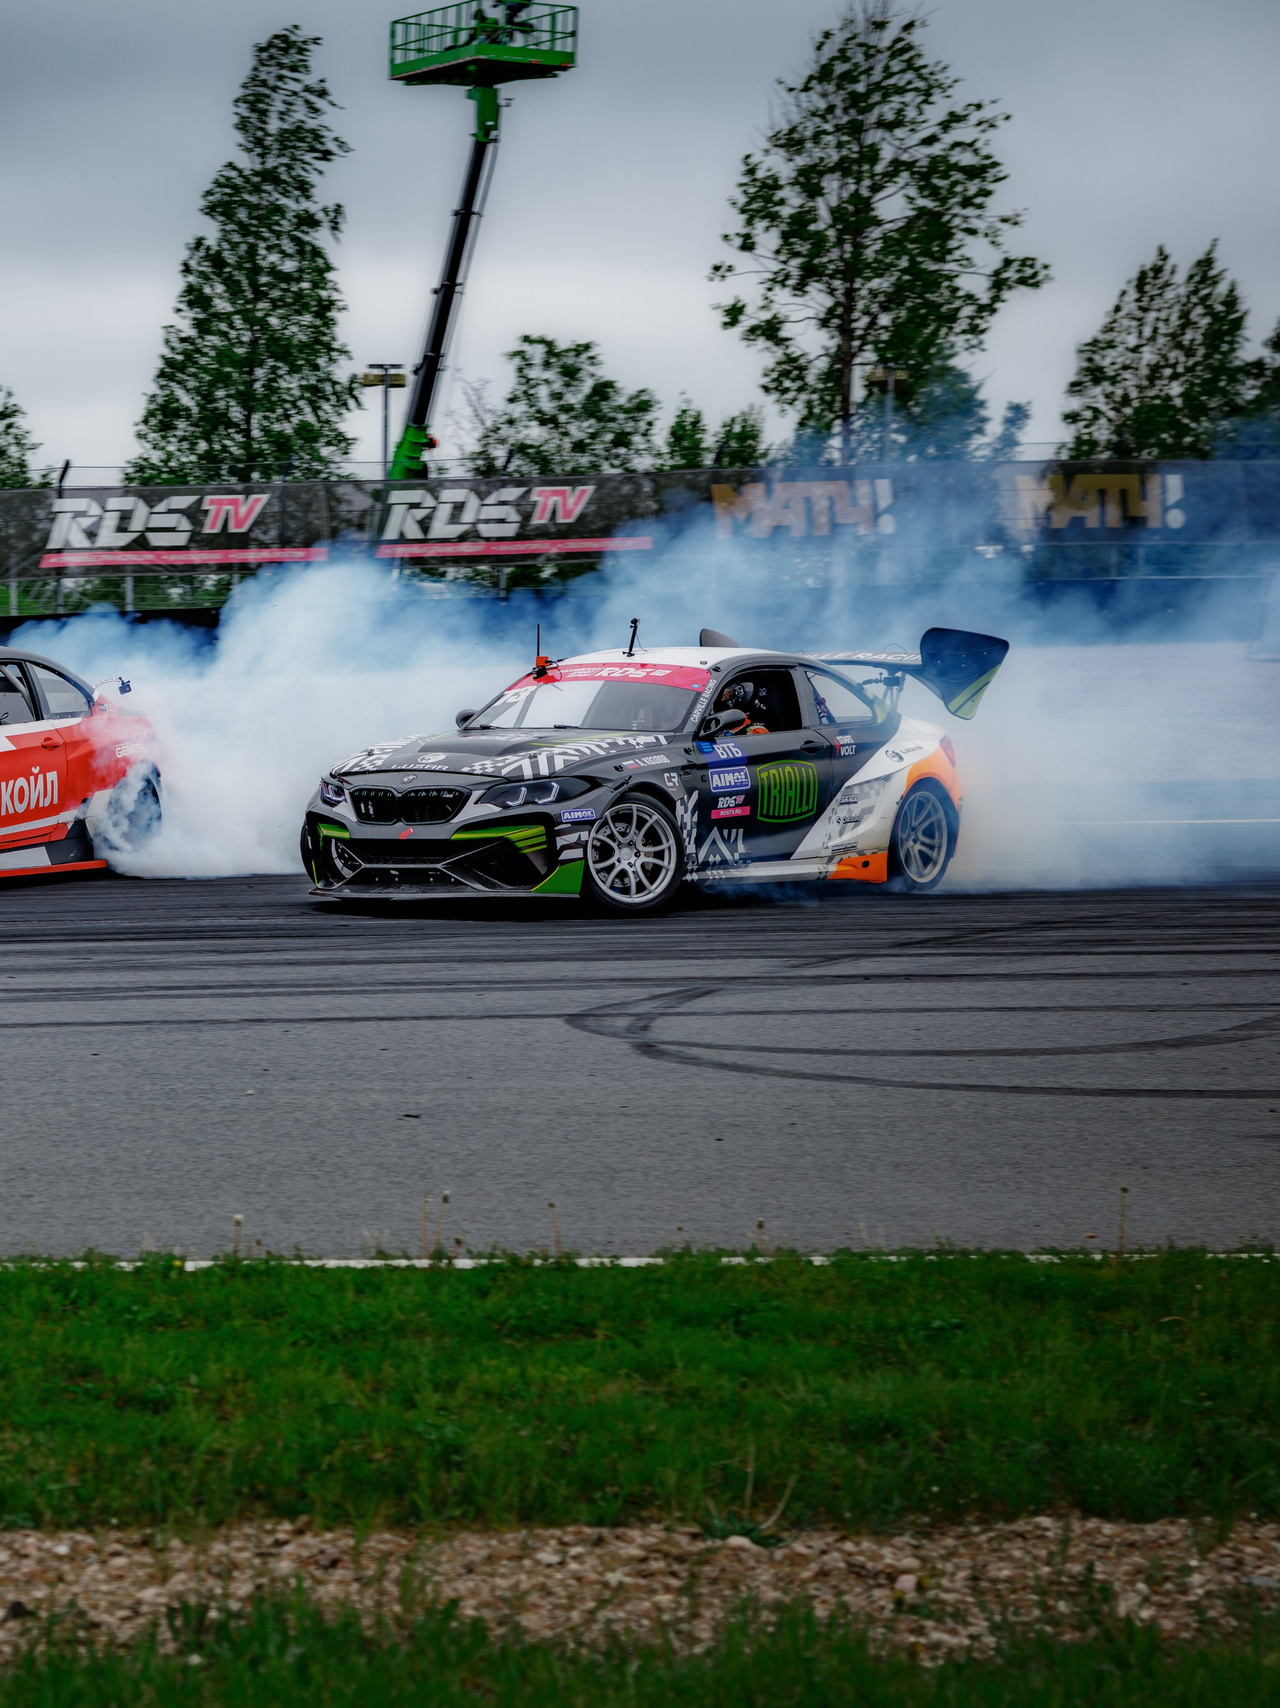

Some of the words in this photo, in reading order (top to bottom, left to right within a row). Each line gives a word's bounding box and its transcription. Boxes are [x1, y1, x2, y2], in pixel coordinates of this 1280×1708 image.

[381, 487, 528, 541] RDS
[528, 485, 597, 525] TV
[45, 495, 202, 550] RDS
[201, 493, 272, 533] TV
[595, 667, 652, 678] RDS
[690, 697, 708, 723] CARVILLE
[702, 678, 718, 699] RACING
[836, 735, 855, 745] START
[713, 743, 743, 759] ВТБ
[840, 745, 857, 756] VOLT
[712, 770, 749, 788] AIMOL
[760, 765, 815, 817] TRIALLI
[717, 796, 737, 809] RDS
[563, 810, 594, 820] AIMOL
